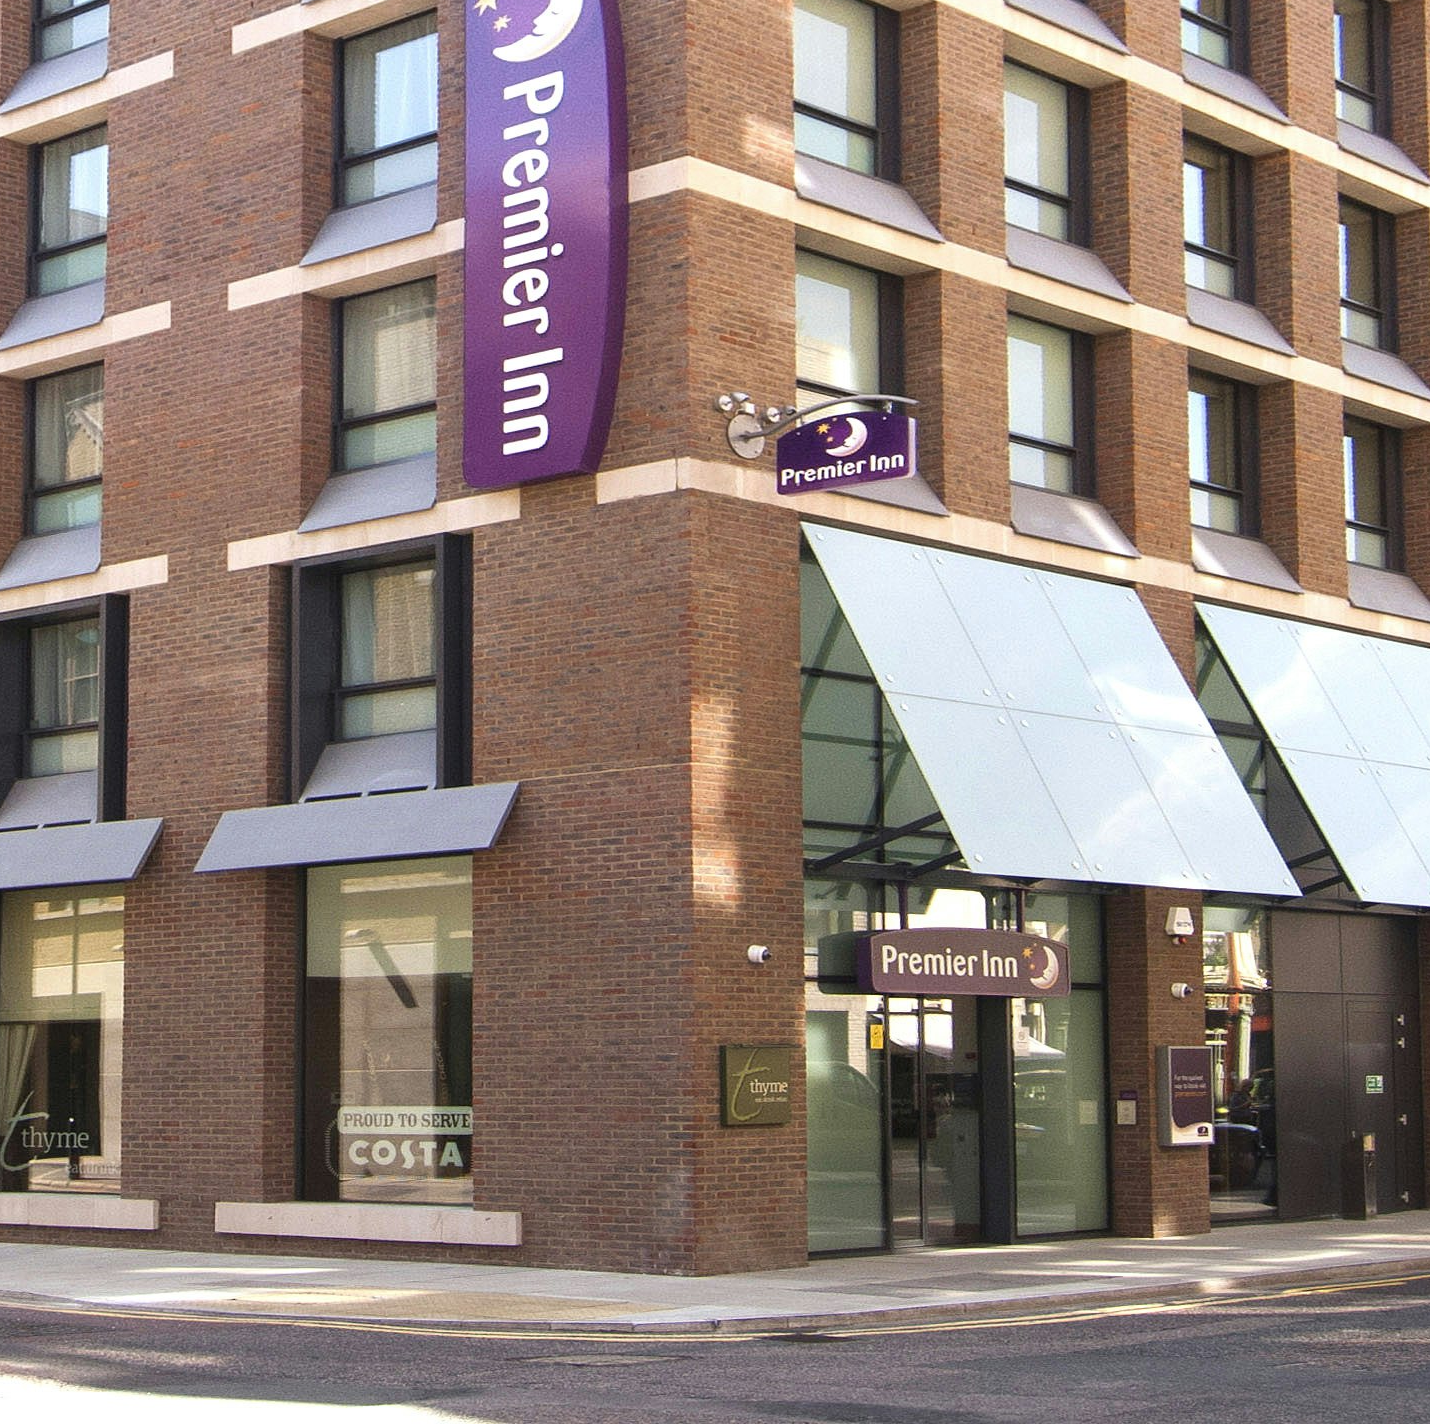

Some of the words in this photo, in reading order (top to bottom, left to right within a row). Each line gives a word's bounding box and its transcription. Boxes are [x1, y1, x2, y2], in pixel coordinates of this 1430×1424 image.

[502, 70, 564, 335] Premier
[502, 347, 563, 455] Inn
[781, 460, 867, 486] Premier
[870, 454, 905, 472] Inn
[881, 945, 978, 977] Premier
[982, 949, 1018, 978] Inn
[749, 1078, 788, 1096] thyme
[343, 1113, 394, 1128] PROUD
[398, 1113, 417, 1127] TO
[421, 1113, 471, 1128] SERVE
[21, 1126, 90, 1154] thyme
[348, 1139, 464, 1169] COSTA
